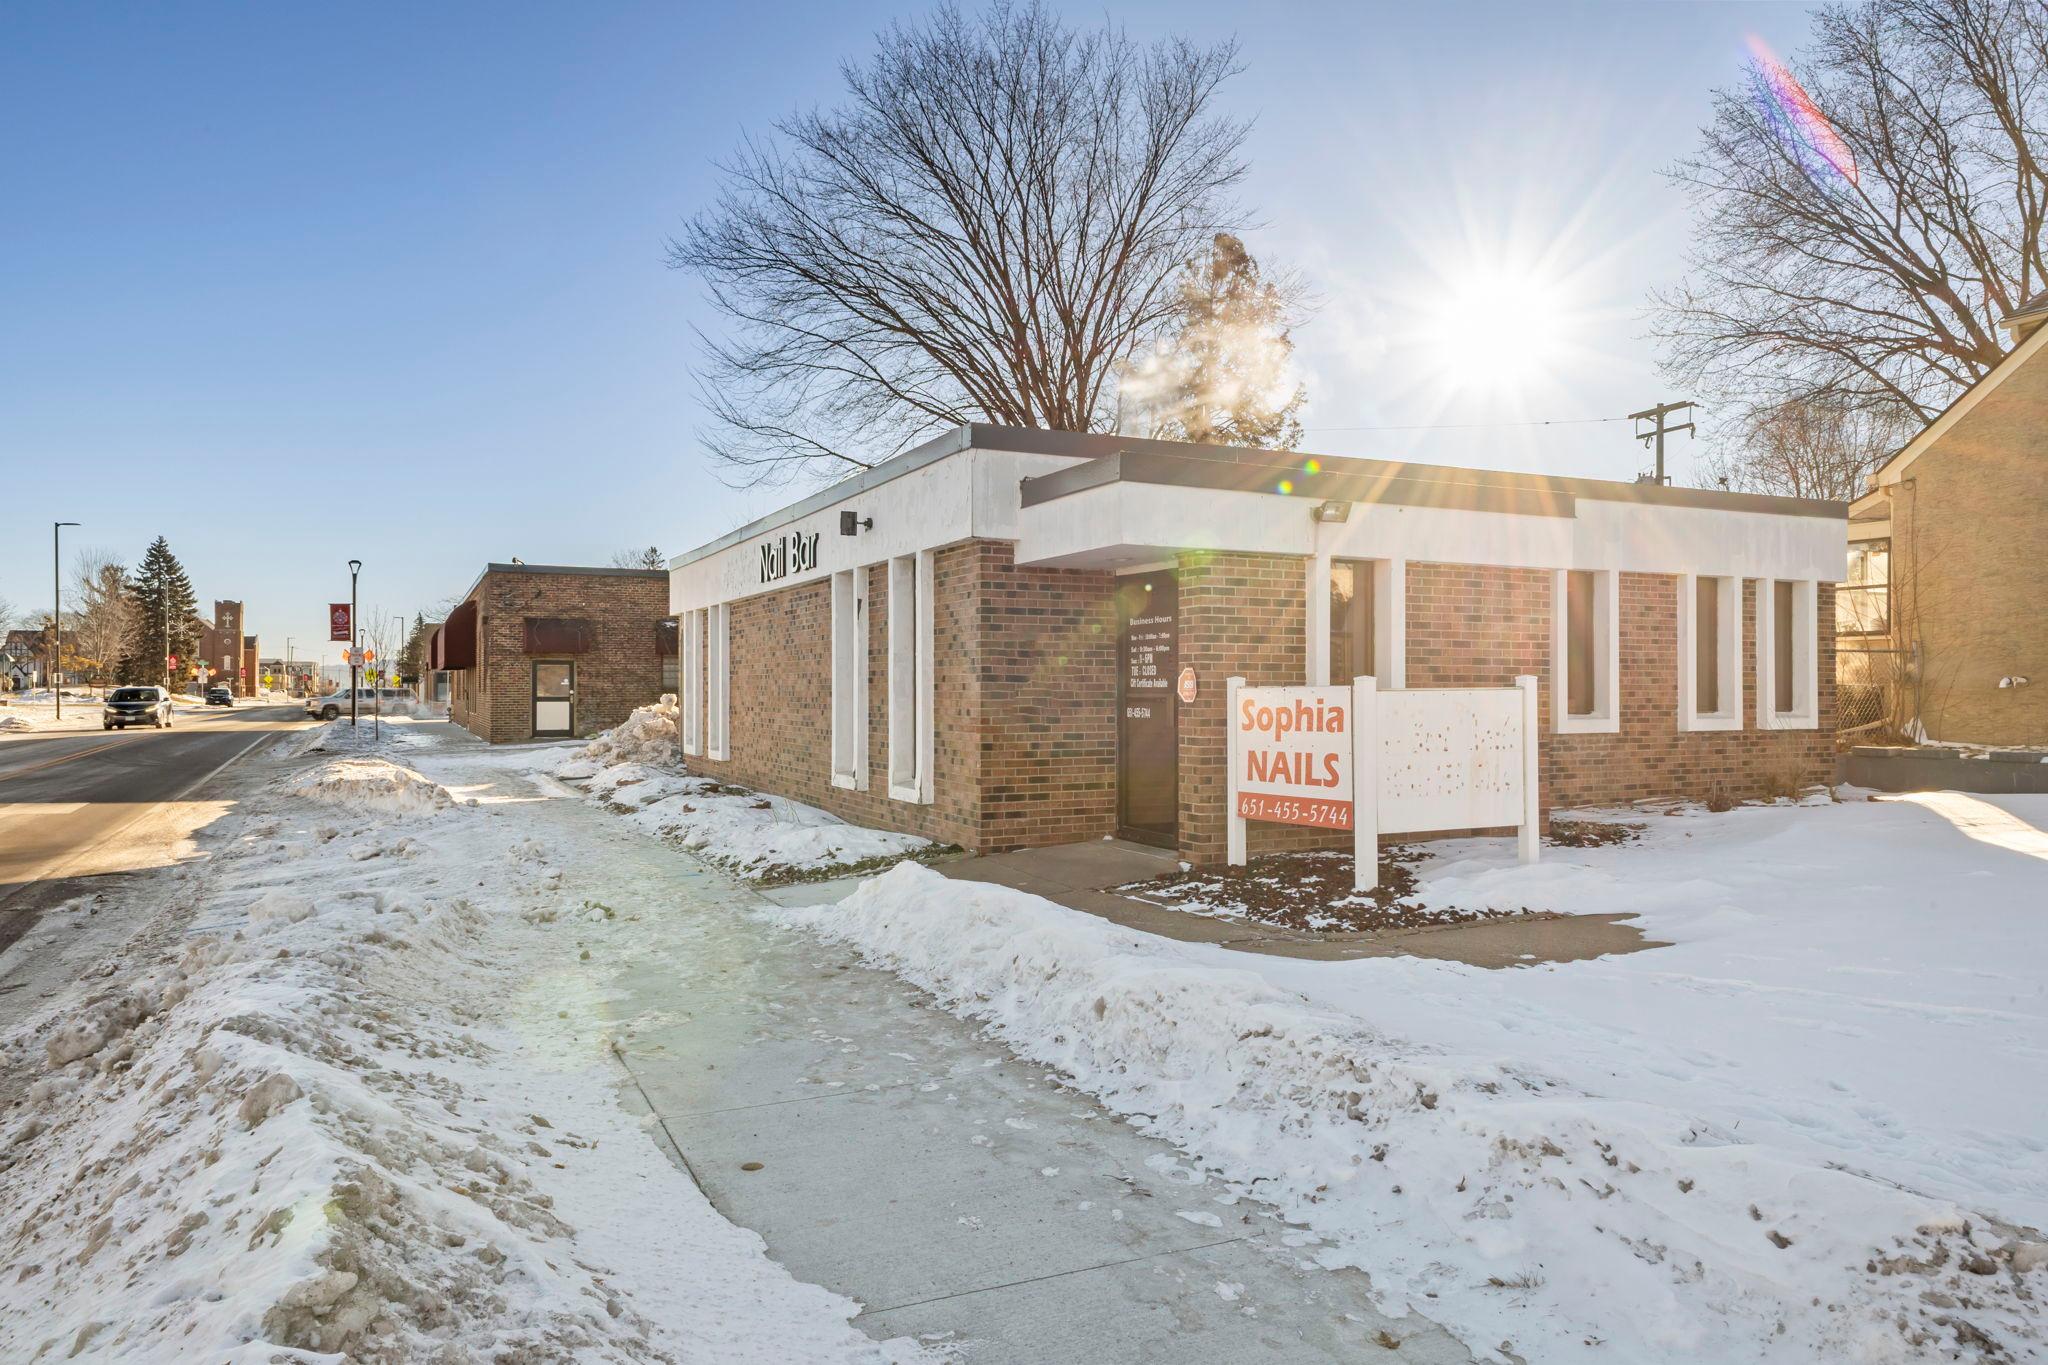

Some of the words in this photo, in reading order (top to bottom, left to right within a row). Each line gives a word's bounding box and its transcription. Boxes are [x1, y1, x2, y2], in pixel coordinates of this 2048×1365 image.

[760, 536, 787, 583] Nail
[791, 531, 820, 574] Bar
[1129, 617, 1154, 626] Business
[1154, 615, 1172, 624] Hours
[1241, 697, 1345, 742] Sophia
[1246, 749, 1340, 788] NAILS
[1241, 797, 1348, 826] 651-455-5744
